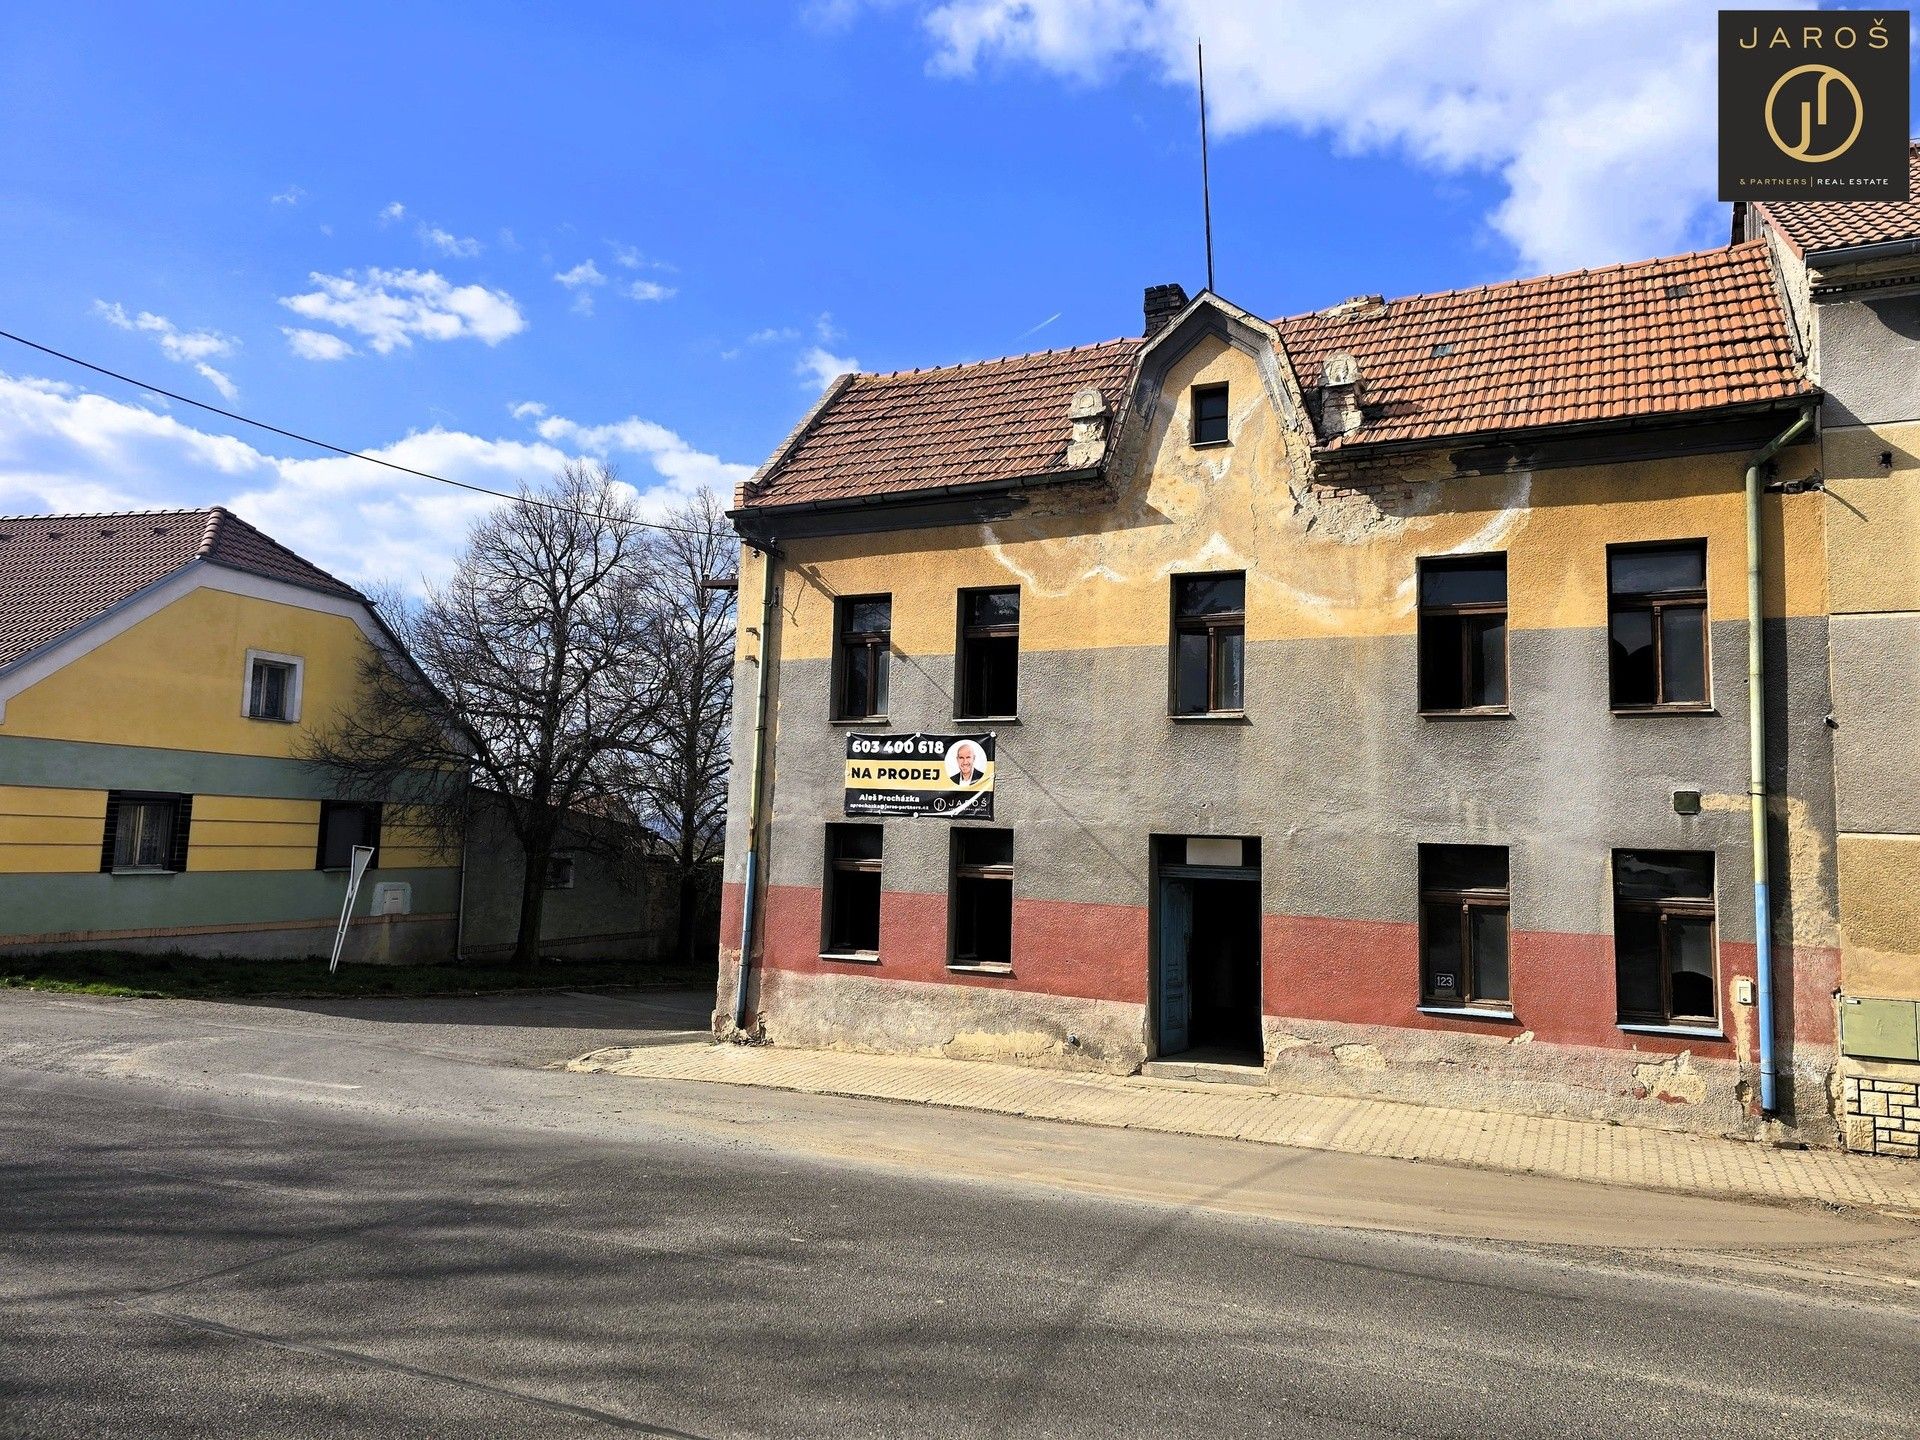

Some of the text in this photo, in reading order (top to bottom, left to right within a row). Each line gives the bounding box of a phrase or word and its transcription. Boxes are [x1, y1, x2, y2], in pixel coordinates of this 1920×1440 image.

[852, 741, 945, 754] 603 400 618
[851, 767, 941, 780] NA PRODEJ
[859, 793, 920, 803] Aleš Procházka
[1437, 976, 1453, 987] 123
